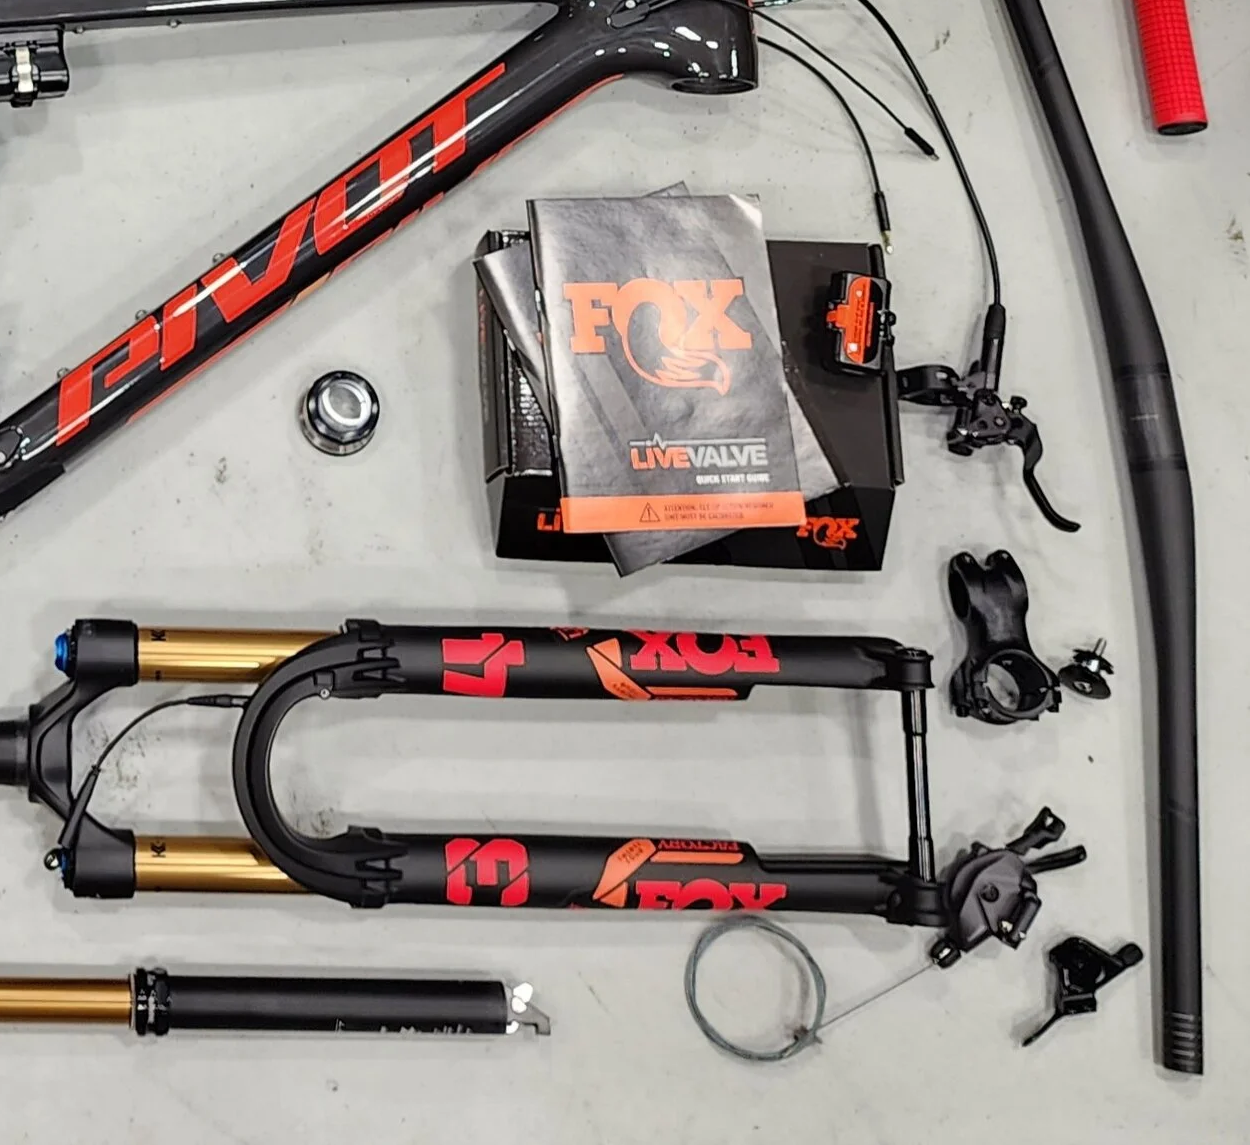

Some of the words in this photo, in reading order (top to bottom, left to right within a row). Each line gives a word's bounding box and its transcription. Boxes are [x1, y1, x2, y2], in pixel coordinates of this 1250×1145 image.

[55, 62, 506, 447] PIVOT
[563, 278, 752, 395] FOX
[630, 444, 769, 470] LIVEVALVE
[796, 517, 860, 549] FOX
[625, 629, 781, 676] FOX
[445, 837, 530, 907] 3
